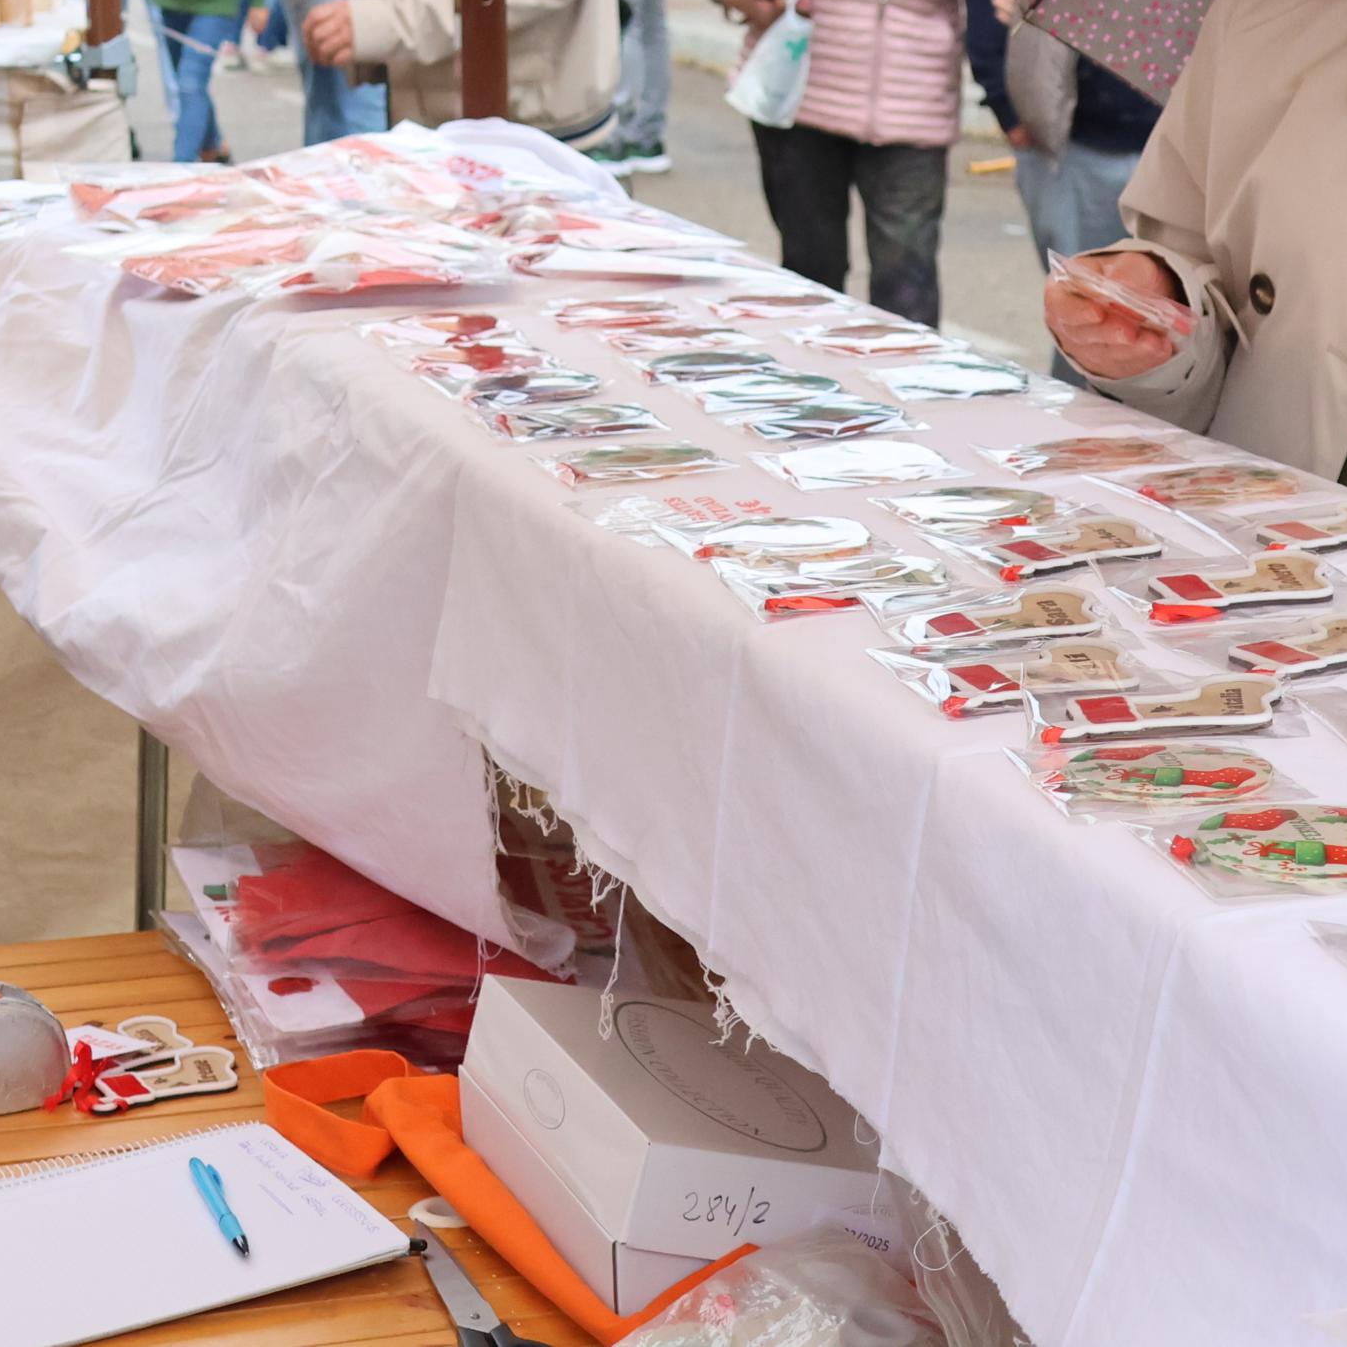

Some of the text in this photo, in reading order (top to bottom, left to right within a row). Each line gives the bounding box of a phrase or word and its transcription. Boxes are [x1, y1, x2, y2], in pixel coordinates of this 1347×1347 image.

[1036, 600, 1075, 627] Sara
[1220, 688, 1246, 716] Natalia
[683, 1186, 771, 1237] 284/2
